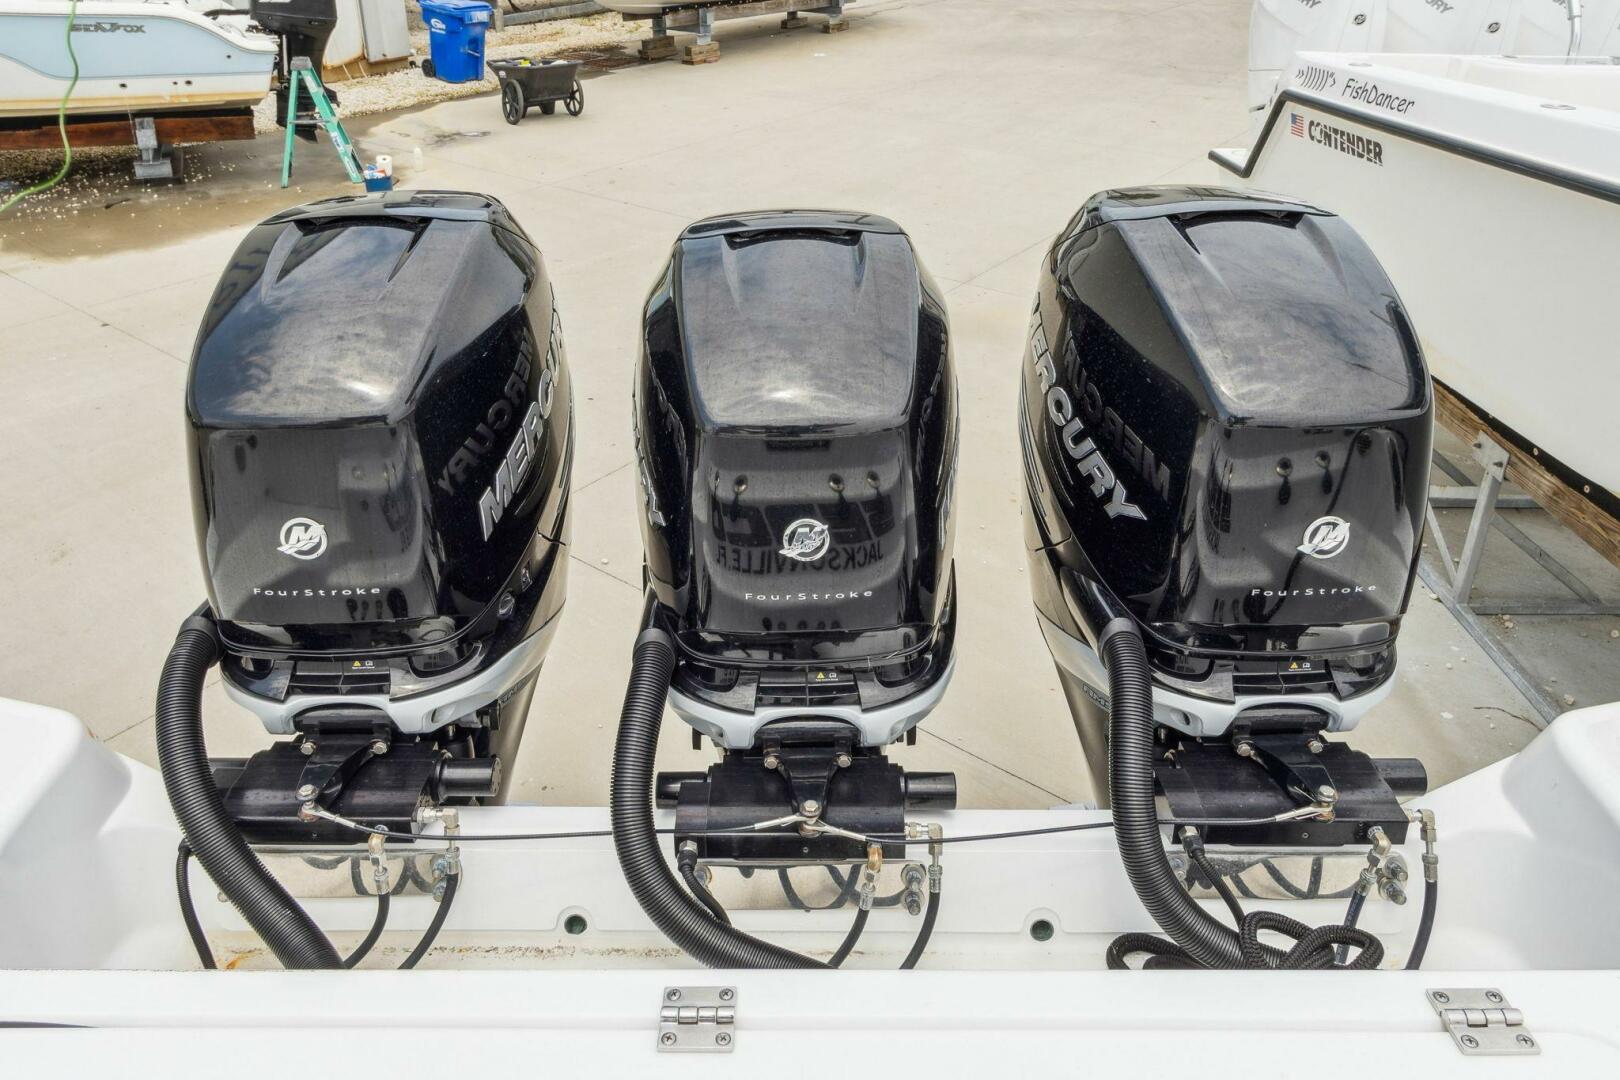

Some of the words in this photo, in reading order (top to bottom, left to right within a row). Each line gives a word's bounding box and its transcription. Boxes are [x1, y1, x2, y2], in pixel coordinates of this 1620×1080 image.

[1341, 77, 1416, 114] FishDancer
[1308, 119, 1384, 167] CONTENDER
[478, 281, 563, 542] MERCU
[253, 586, 381, 597] FourStroke
[745, 589, 873, 601] FourStroke
[1250, 584, 1377, 597] FourStroke
